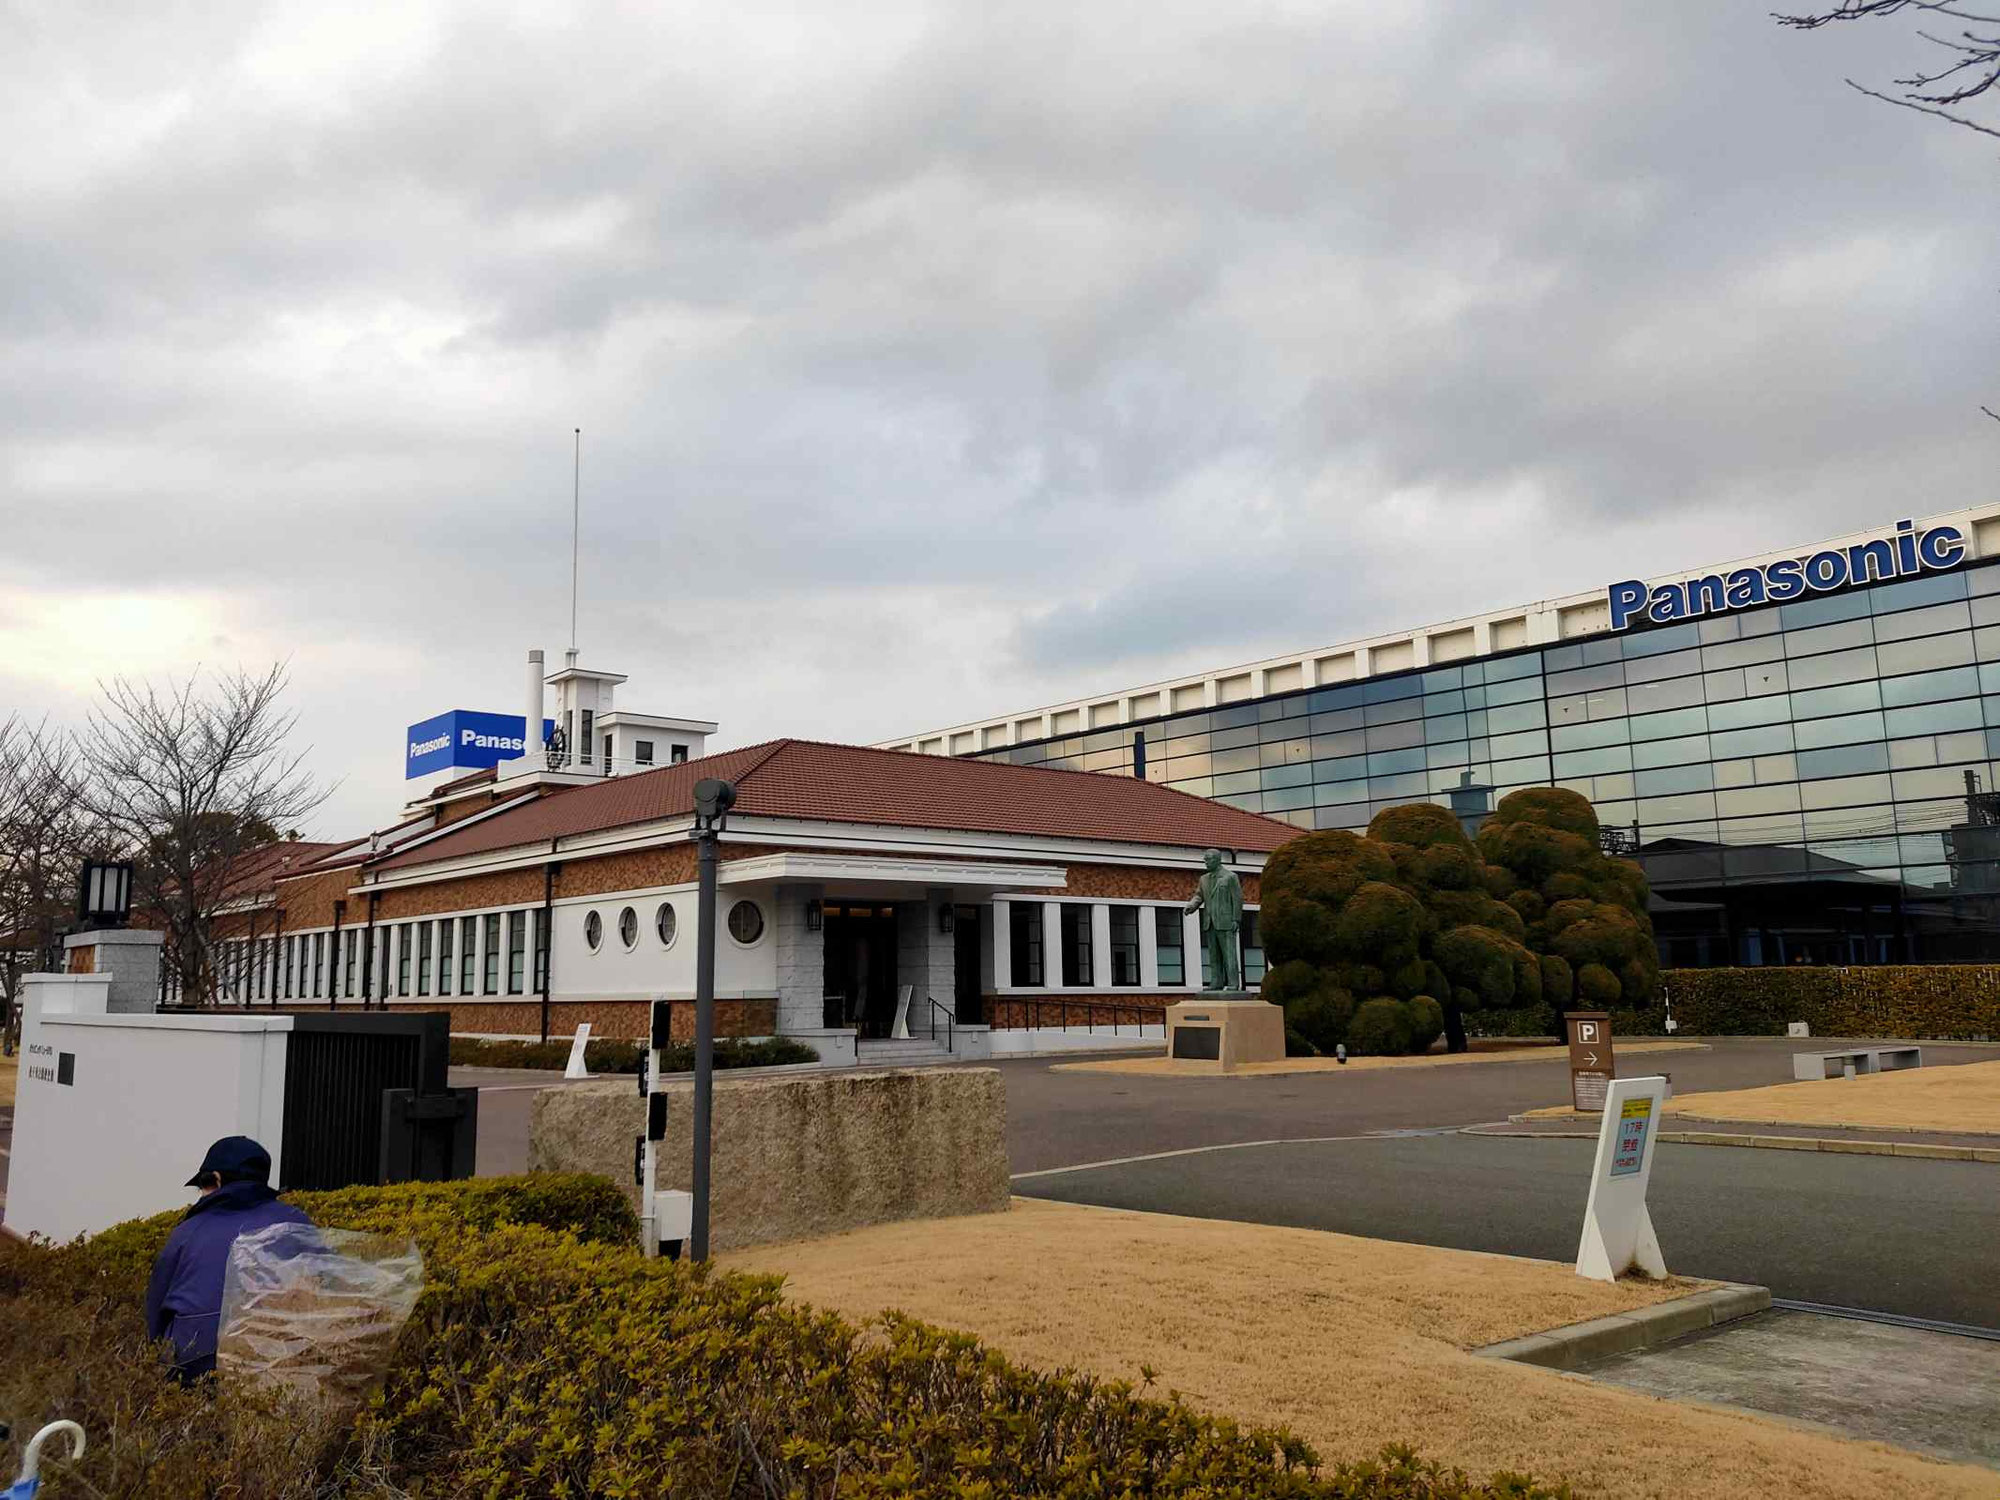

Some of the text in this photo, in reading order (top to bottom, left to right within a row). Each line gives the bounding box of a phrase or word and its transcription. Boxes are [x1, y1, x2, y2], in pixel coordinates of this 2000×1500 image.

[1608, 518, 1966, 631] Panasonic
[410, 733, 450, 758] Panasonic
[1582, 1024, 1594, 1040] P
